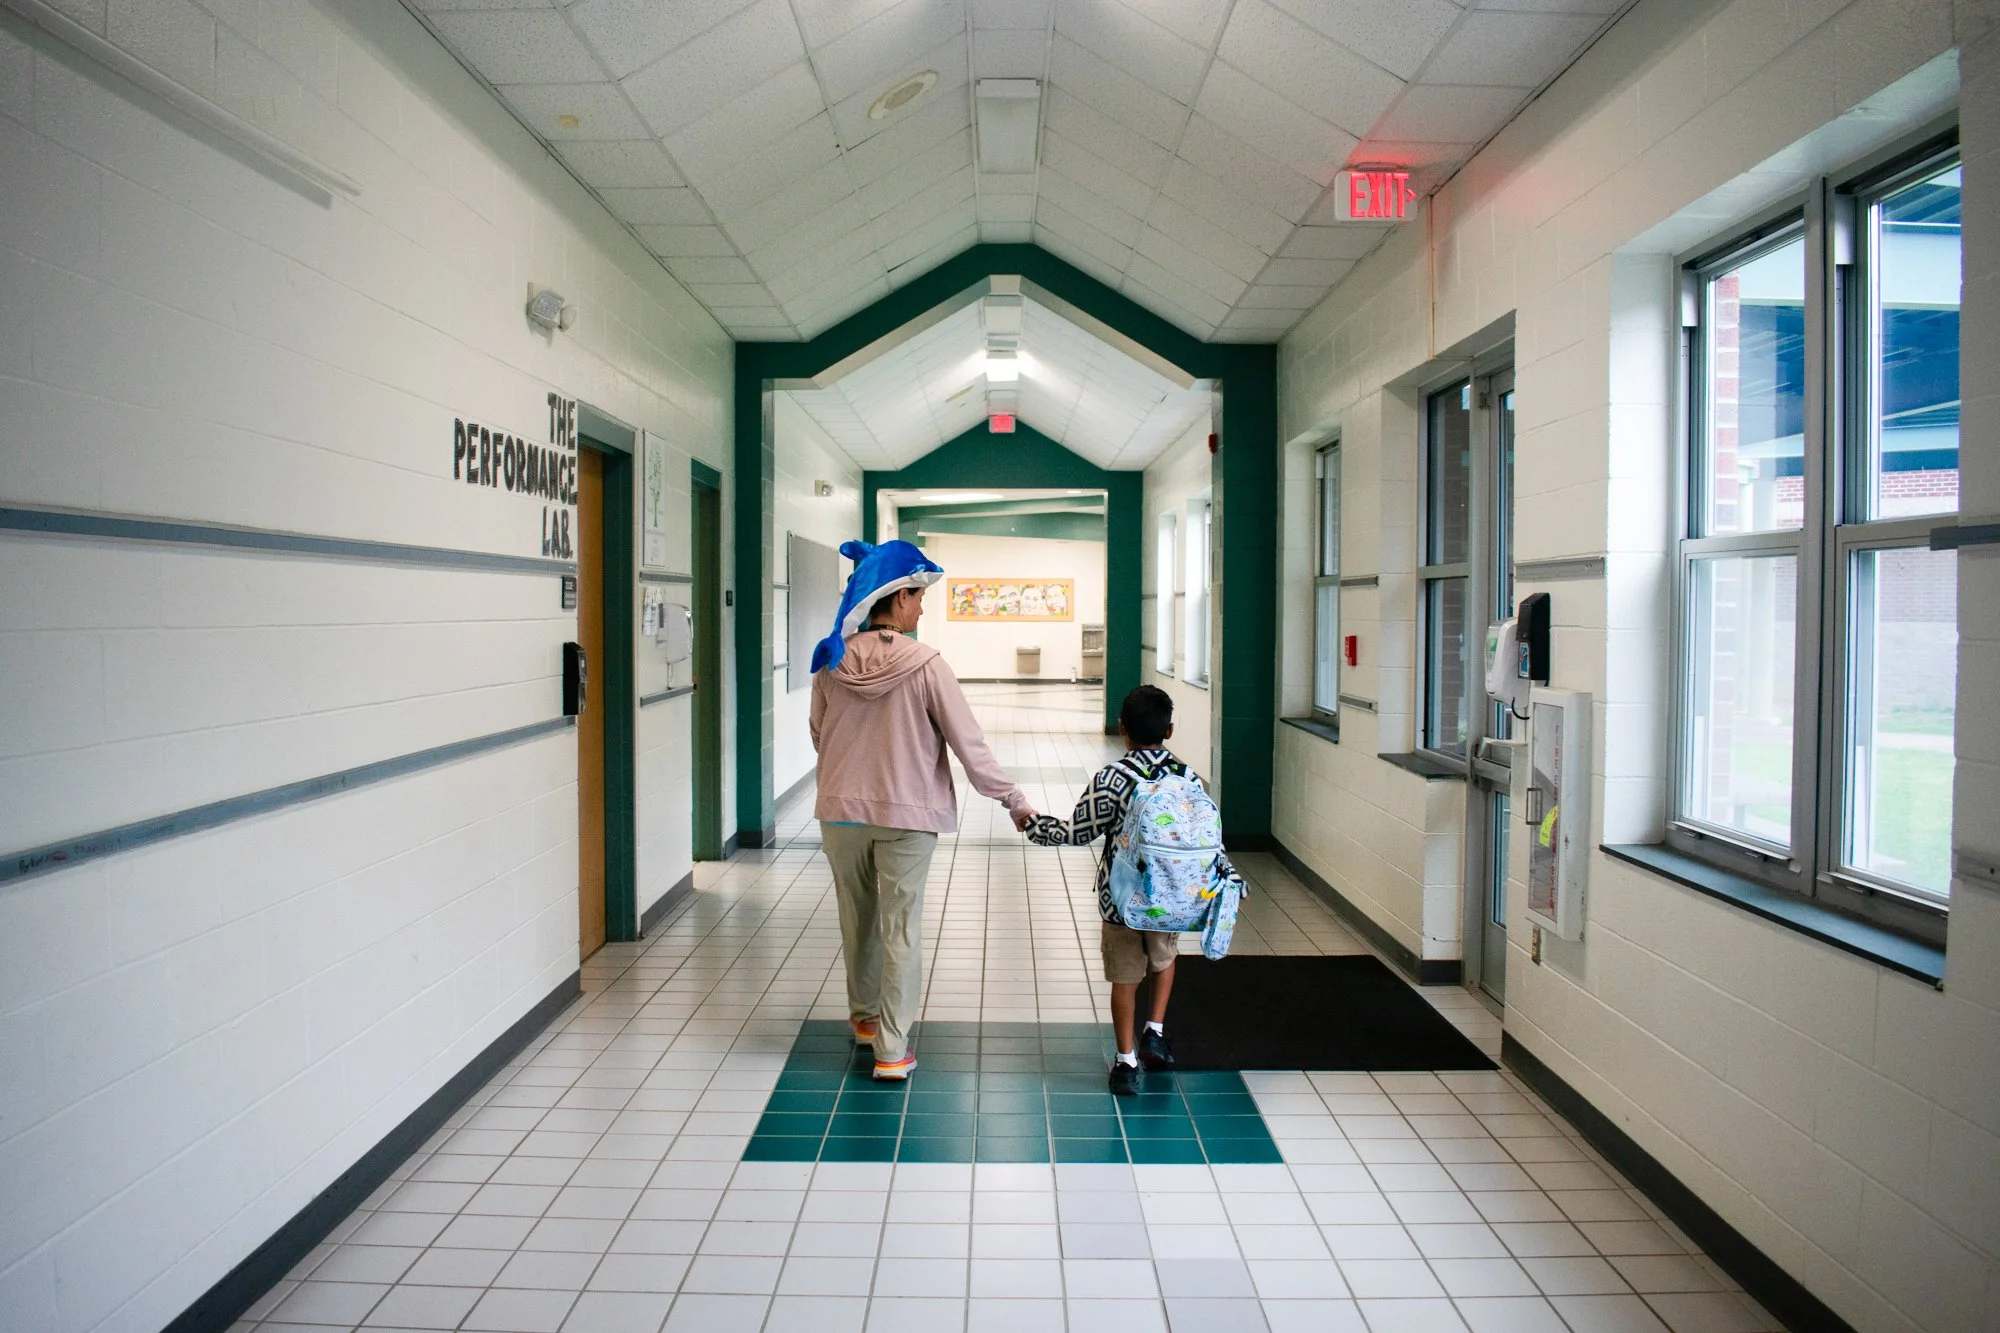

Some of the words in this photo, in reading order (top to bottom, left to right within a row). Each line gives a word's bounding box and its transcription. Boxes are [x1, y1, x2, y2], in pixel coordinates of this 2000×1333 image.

[1350, 172, 1409, 218] EXIT
[547, 391, 576, 450] THE
[453, 417, 577, 506] PERFORMANCE
[542, 505, 573, 559] LAB.
